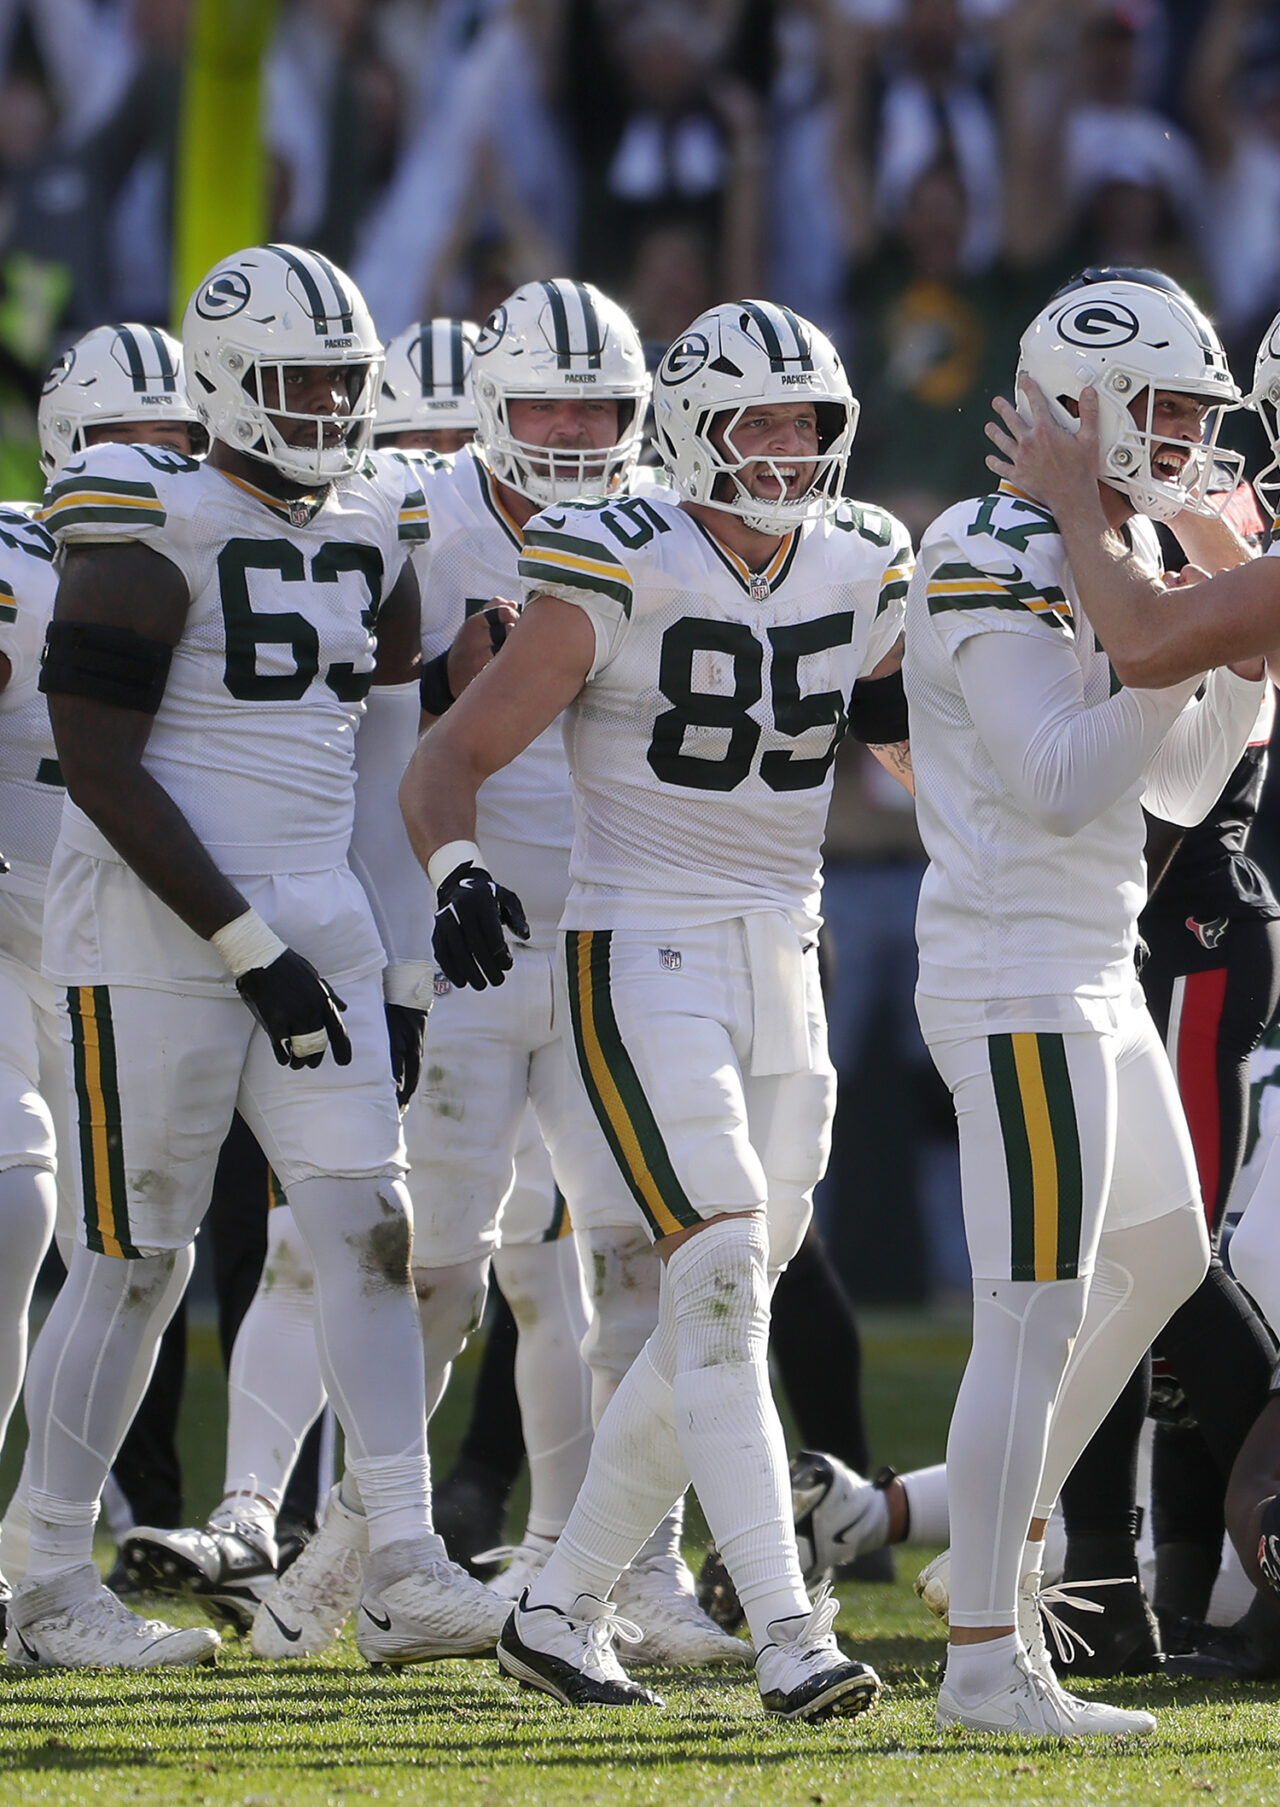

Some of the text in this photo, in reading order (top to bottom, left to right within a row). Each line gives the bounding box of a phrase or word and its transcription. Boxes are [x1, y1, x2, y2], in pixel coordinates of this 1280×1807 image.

[324, 338, 353, 349] PACKERS
[564, 373, 597, 384] PACKERS
[217, 537, 385, 703] 63
[647, 610, 855, 793] 85
